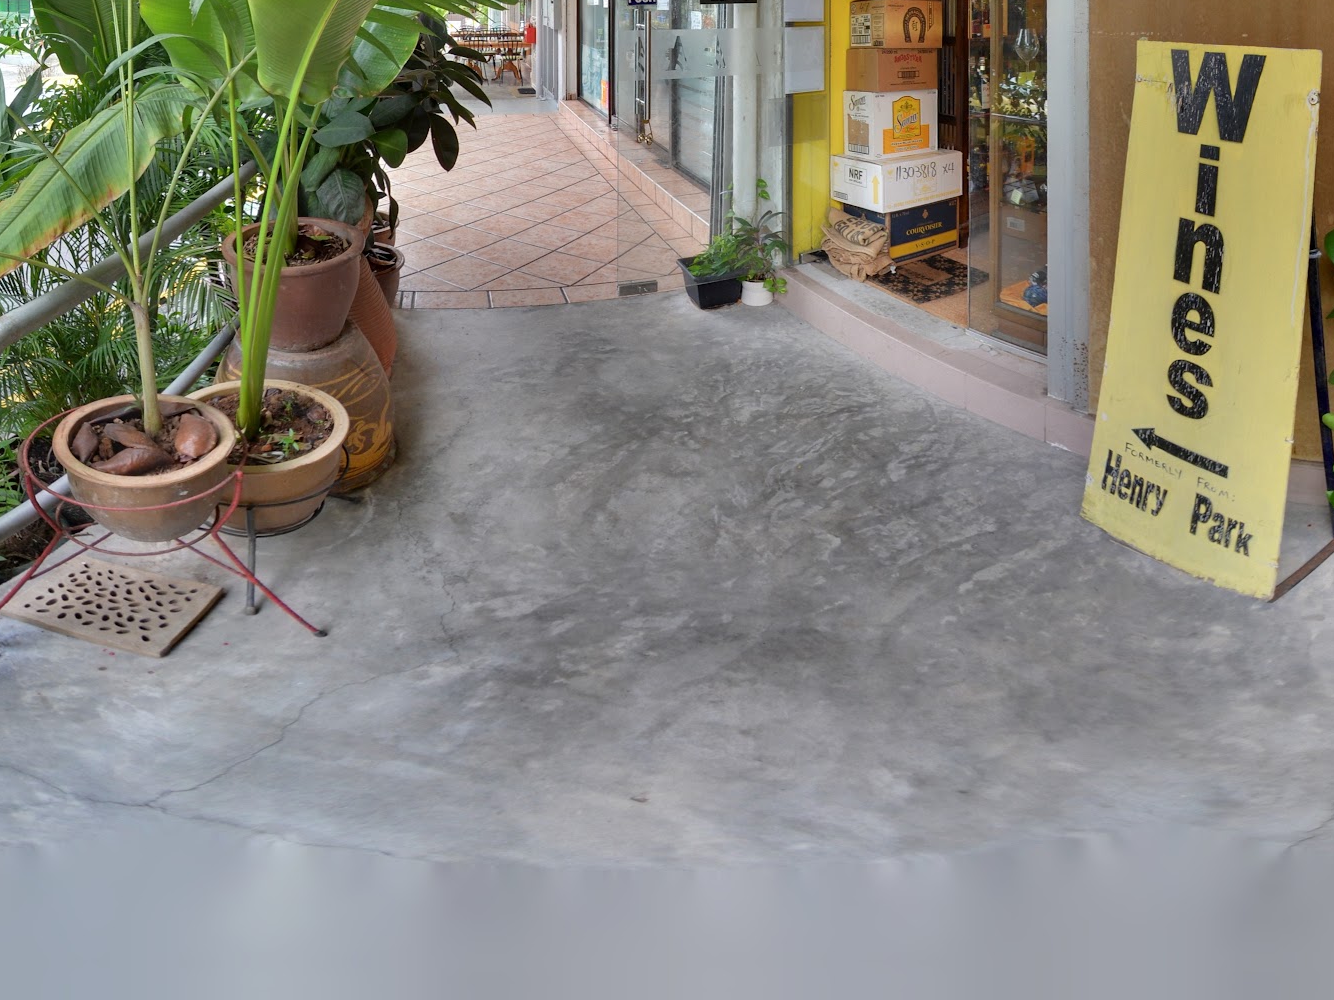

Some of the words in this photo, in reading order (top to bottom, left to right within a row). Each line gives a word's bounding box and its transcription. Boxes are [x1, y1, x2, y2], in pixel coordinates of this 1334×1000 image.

[848, 168, 863, 181] NRF
[895, 161, 937, 182] 11303818
[906, 221, 943, 236] COURVOISIER
[1165, 48, 1267, 420] Wines
[1124, 441, 1183, 480] FORMERLY
[1196, 476, 1236, 503] FROM:
[1101, 448, 1169, 517] Henry
[1189, 492, 1253, 557] Park
